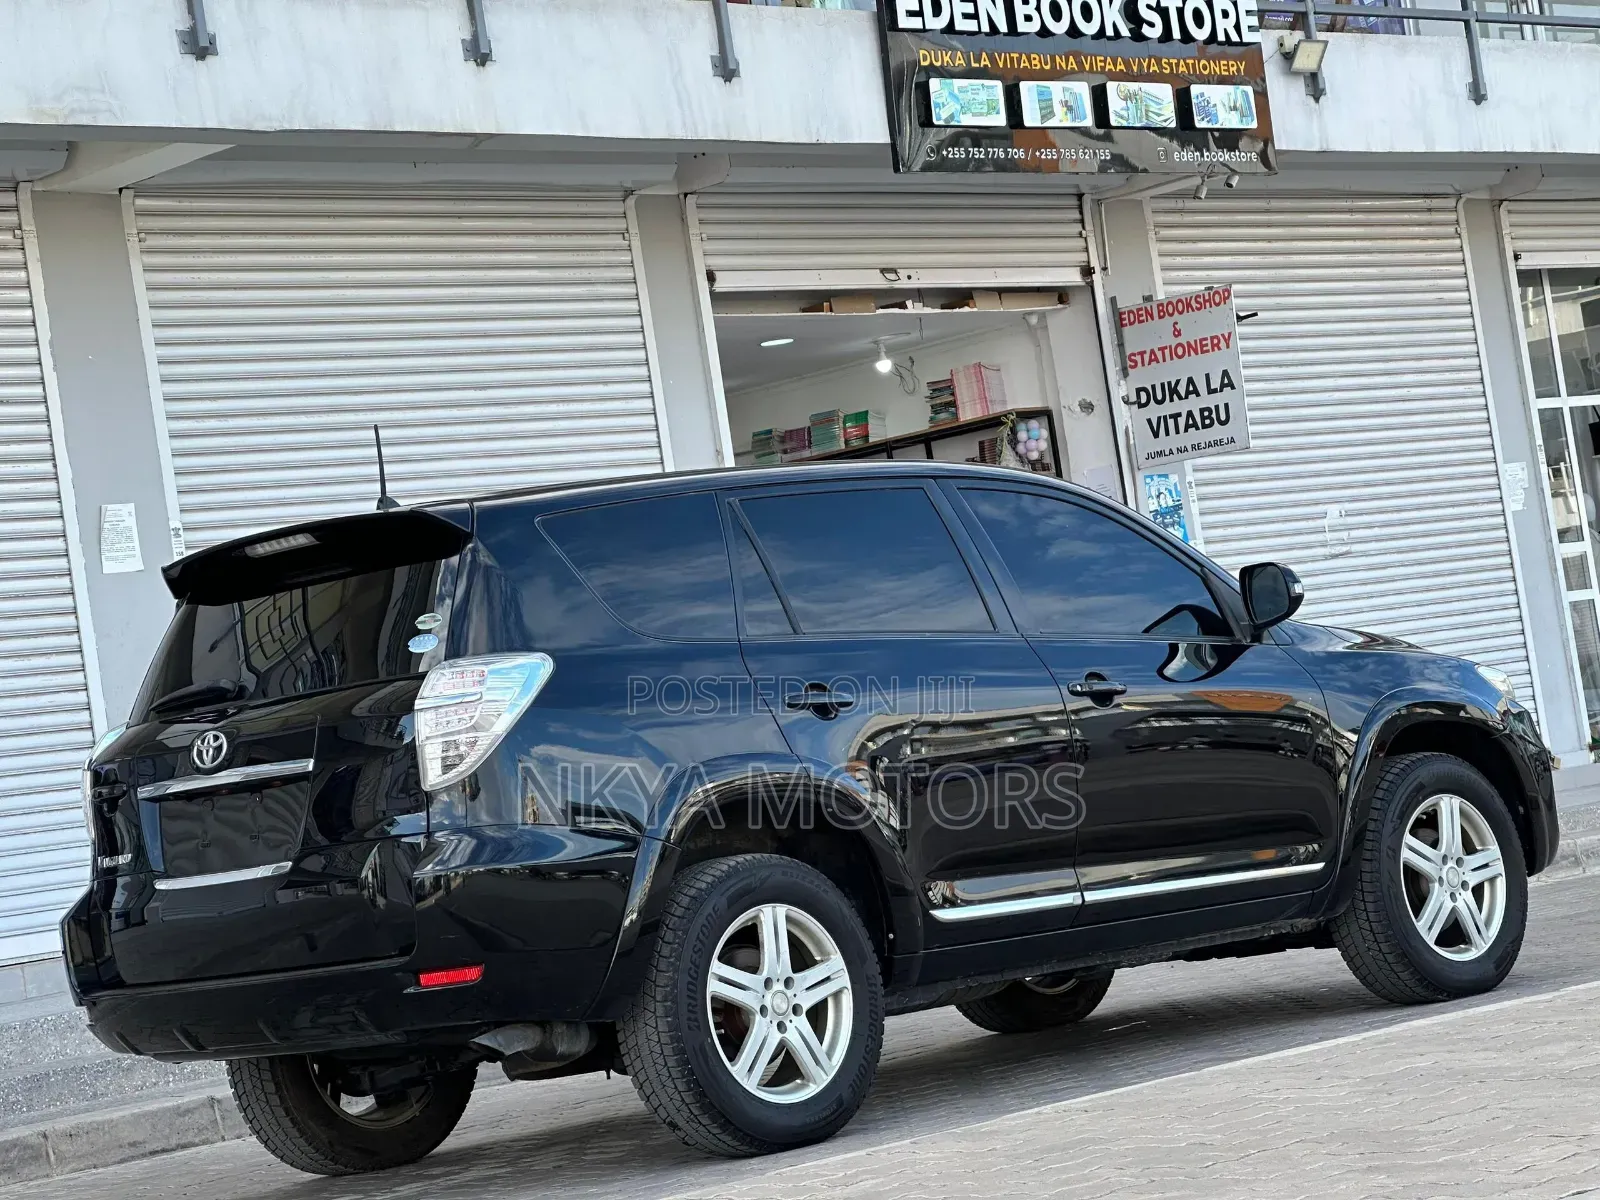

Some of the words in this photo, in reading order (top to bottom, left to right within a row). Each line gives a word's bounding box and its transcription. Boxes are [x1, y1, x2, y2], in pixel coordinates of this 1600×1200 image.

[896, 0, 1008, 34] EDEN
[1015, 0, 1130, 38] BOOK
[1140, 0, 1262, 43] STORE
[919, 50, 967, 68] DUKA
[970, 51, 992, 68] LA
[994, 52, 1052, 70] VITABU
[1055, 54, 1079, 71] NA
[1081, 55, 1127, 72] VIFAA
[1129, 57, 1160, 73] VYA
[1161, 58, 1247, 76] STATIONERY
[941, 147, 966, 159] +255
[968, 148, 985, 159] 752
[987, 148, 1005, 159] 776
[1007, 148, 1026, 159] 706
[1035, 149, 1058, 159] +255
[1060, 149, 1077, 160] 785
[1078, 149, 1094, 160] 621
[1096, 149, 1112, 160] 155
[1173, 148, 1259, 162] eden.bookstore
[1119, 305, 1155, 328] EDEN
[1156, 287, 1232, 321] BOOKSHOP
[1172, 321, 1183, 339] &
[1127, 332, 1233, 370] STATIONERY
[1135, 376, 1202, 410] DUKA
[1204, 368, 1237, 395] LA
[1146, 402, 1232, 440] VITABU
[1145, 448, 1175, 461] JUMLA
[1176, 445, 1190, 455] NA
[1191, 435, 1236, 452] REJAREJA
[685, 903, 722, 1033] BRIDGESTONE
